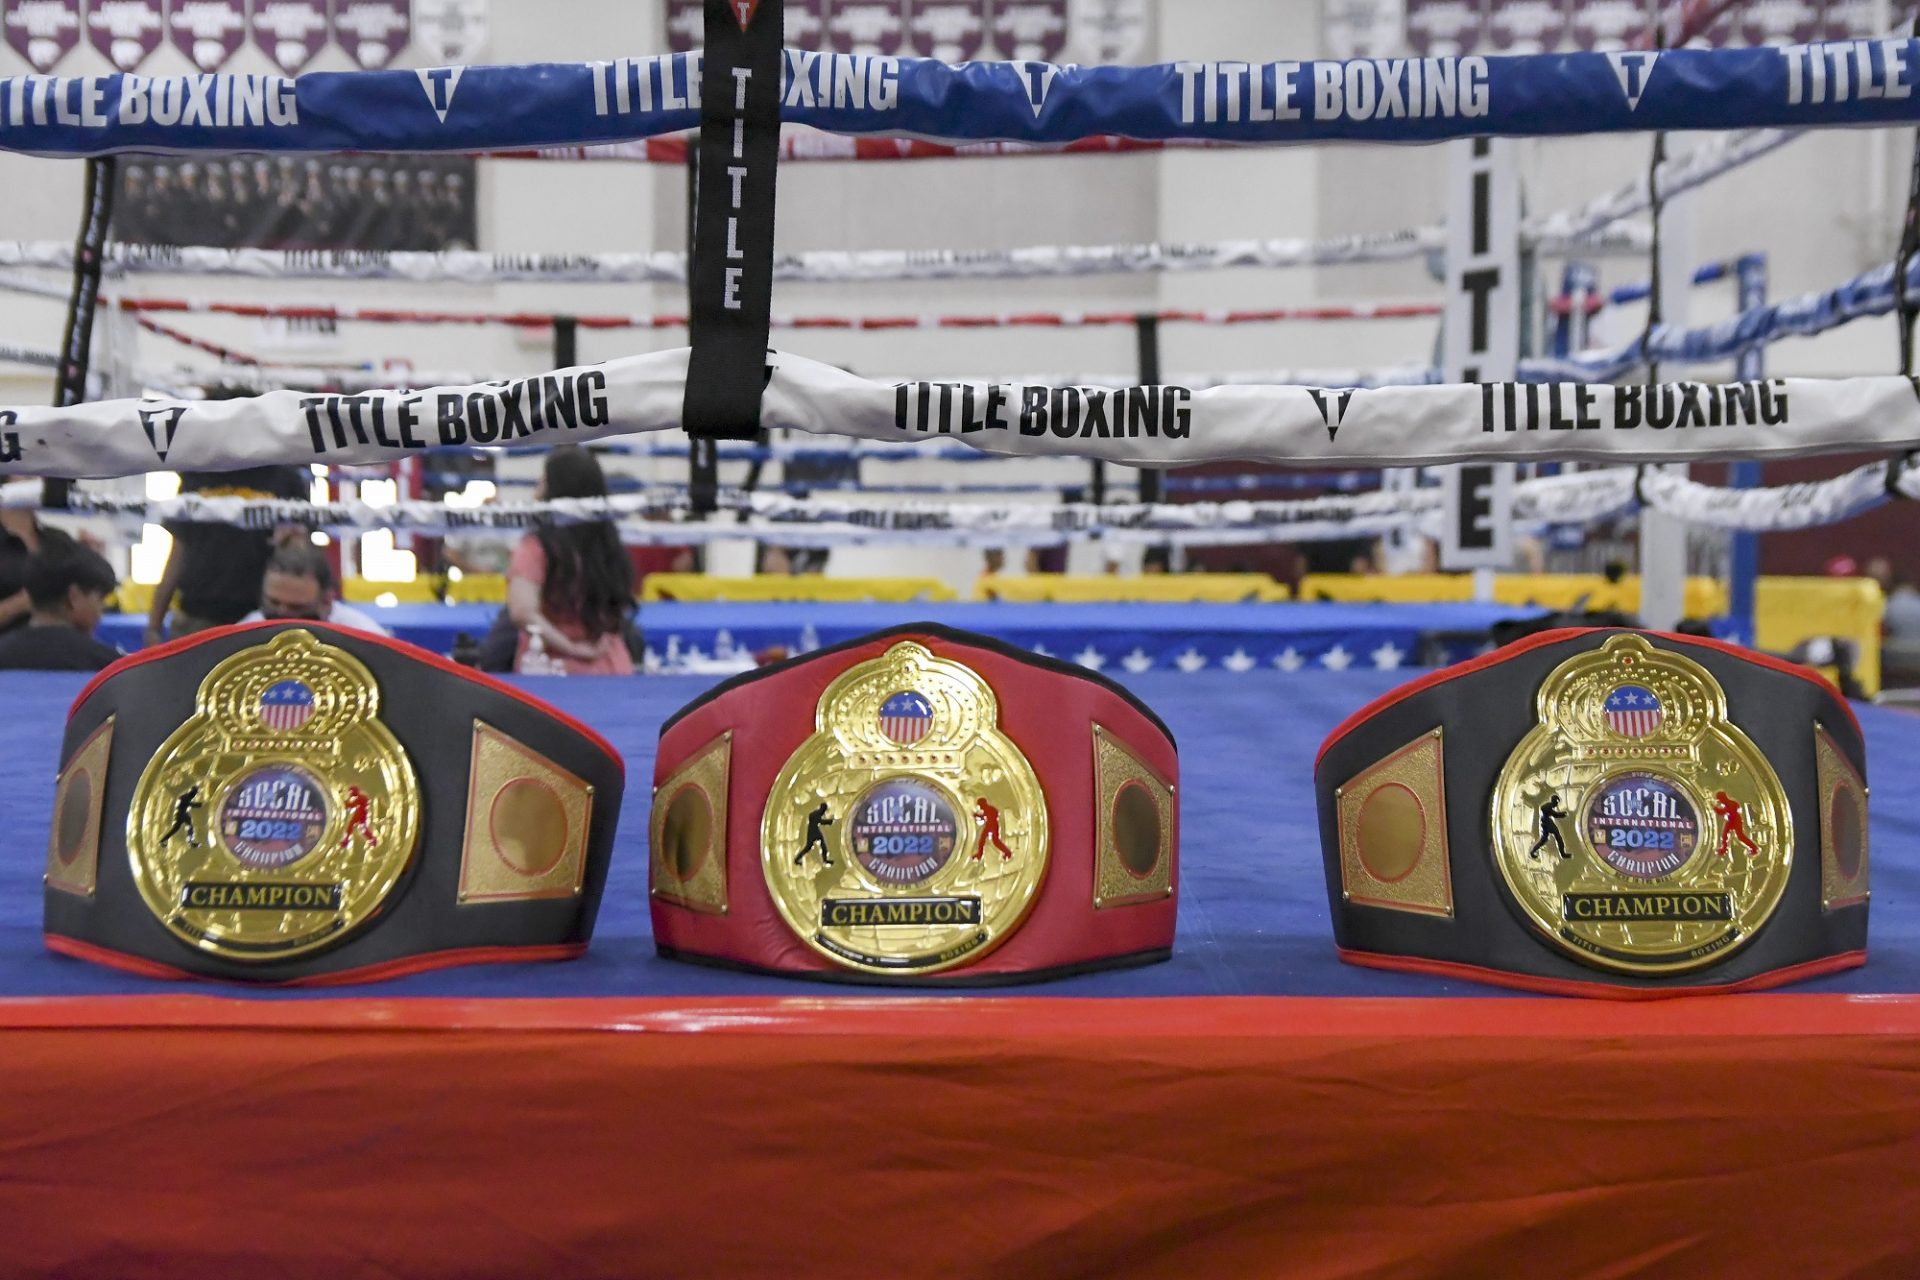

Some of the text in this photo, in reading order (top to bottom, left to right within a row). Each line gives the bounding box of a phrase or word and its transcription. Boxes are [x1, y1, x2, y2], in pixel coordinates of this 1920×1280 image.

[779, 50, 900, 111] XING
[1779, 39, 1912, 104] TITLE
[0, 72, 299, 127] ITLE BOXING
[1175, 55, 1489, 123] TITLE BOXING
[724, 67, 752, 309] TITLE
[299, 371, 608, 453] TITLE BOXING
[892, 381, 1191, 439] TITLE BOXING
[1614, 380, 1789, 429] BOXING
[226, 808, 322, 821] INTERNATIONAL
[1593, 817, 1692, 829] INTERNATIONAL
[240, 819, 303, 840] 2022
[857, 824, 951, 834] INTERNATIONAL
[1611, 828, 1675, 849] 2022
[873, 835, 934, 857] 2022
[869, 857, 938, 880] CHAMPION
[1607, 850, 1680, 874] CHAMPION
[191, 886, 332, 906] CHAMPION
[1575, 896, 1722, 917] CHAMPION
[831, 902, 972, 924] CHAMPION
[1690, 935, 1731, 959] BOXING
